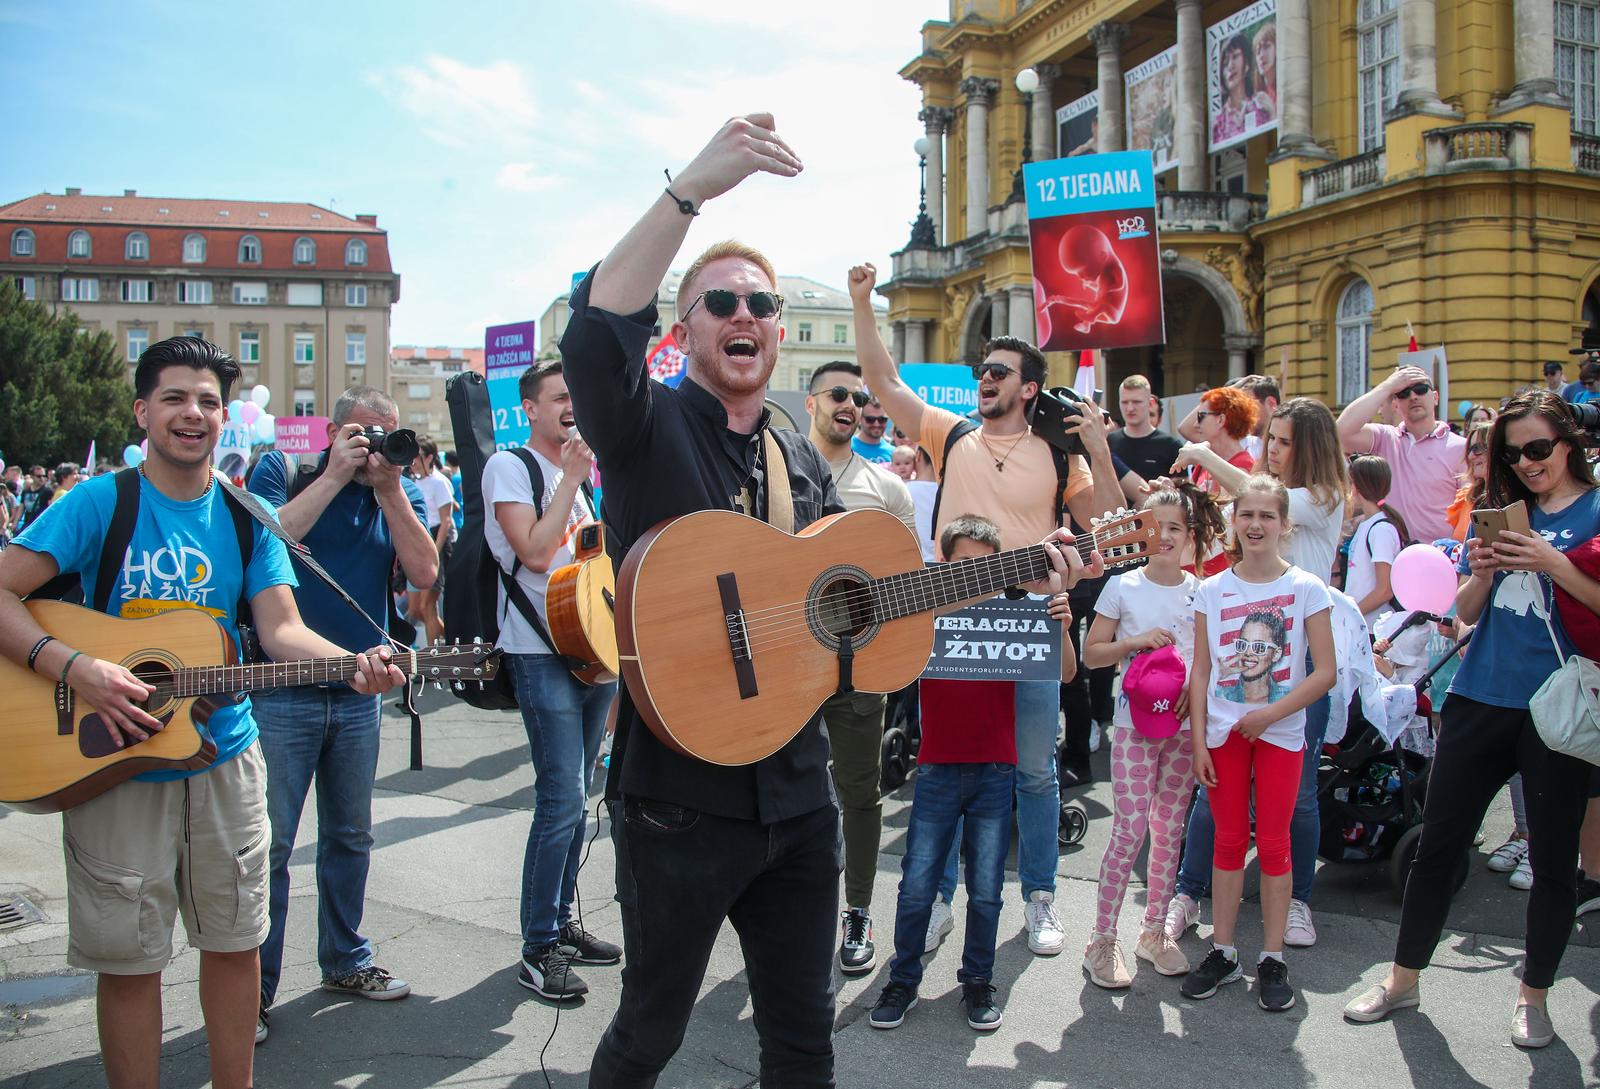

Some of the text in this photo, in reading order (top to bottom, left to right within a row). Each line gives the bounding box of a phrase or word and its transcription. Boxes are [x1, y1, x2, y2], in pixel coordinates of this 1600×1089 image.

[1036, 169, 1141, 202] 12 TJEDANA
[495, 334, 524, 348] 4 TJEDNA
[487, 354, 496, 367] OD
[519, 350, 531, 363] IMA
[918, 385, 928, 401] 9
[491, 408, 509, 431] 12
[221, 429, 237, 447] ZA
[123, 545, 212, 590] HOD
[120, 579, 216, 607] ZA ŽIVOT
[944, 634, 1051, 661] ŽIVOT
